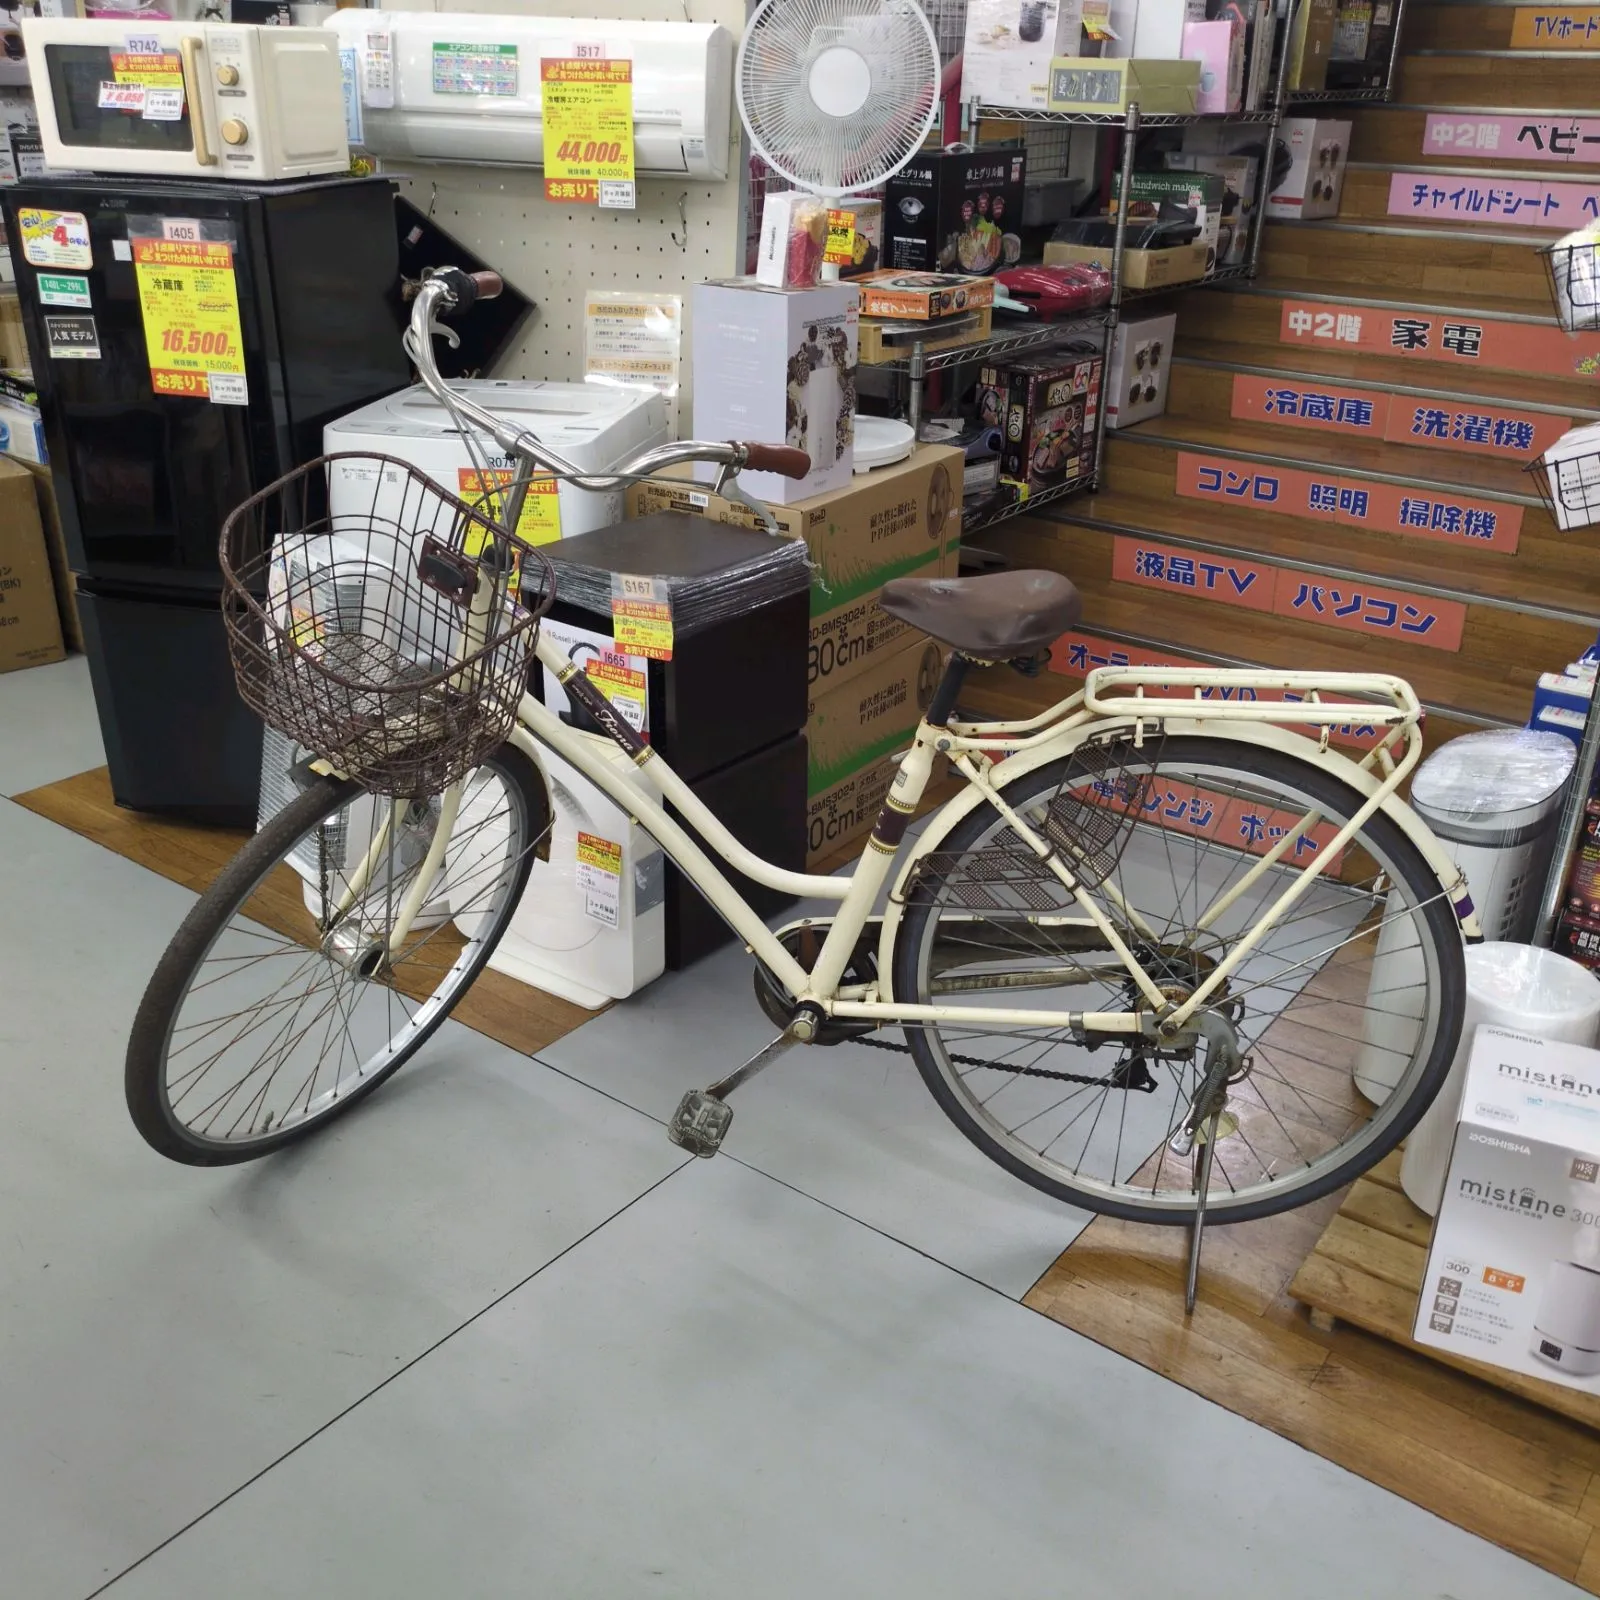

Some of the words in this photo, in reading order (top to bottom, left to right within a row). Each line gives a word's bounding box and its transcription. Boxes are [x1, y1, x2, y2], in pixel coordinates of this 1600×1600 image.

[129, 40, 159, 53] R742
[1431, 122, 1501, 149] 中2階
[1172, 182, 1201, 192] maker
[1412, 184, 1560, 216] チャイルドシート
[152, 278, 184, 292] 冷蔵庫
[1288, 309, 1363, 343] 中2階
[162, 329, 237, 357] 16,500円
[1263, 388, 1373, 427] 冷蔵庫
[1410, 407, 1536, 450] 洗濯機
[1197, 467, 1280, 502] コンロ
[1307, 483, 1369, 518] 照明
[1399, 497, 1498, 540] 掃除機
[625, 581, 651, 594] S167
[1135, 548, 1257, 596] 液晶TV
[1291, 583, 1437, 635] パソコン
[1240, 813, 1319, 856] ポット
[1487, 1028, 1545, 1047] DOSHISHA
[1468, 1131, 1532, 1156] DOSHISHA
[1446, 1261, 1471, 1275] 300
